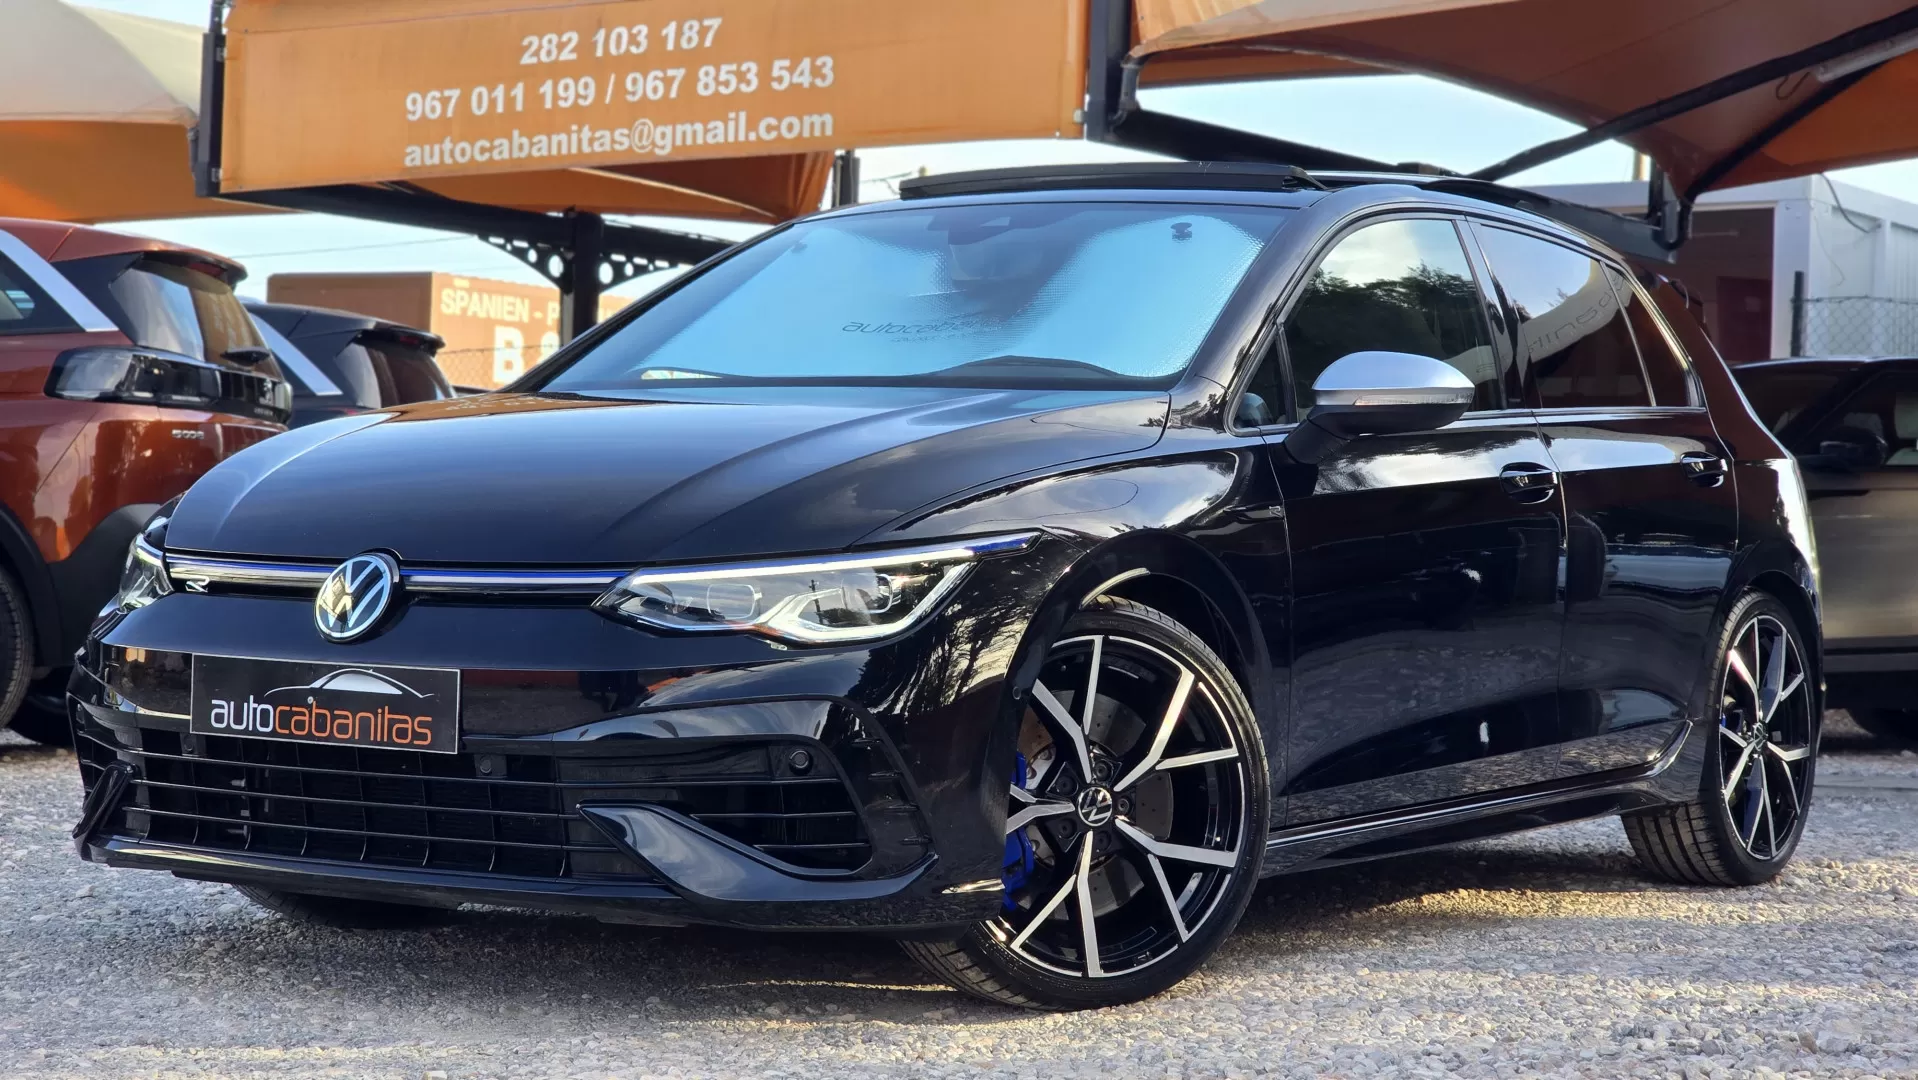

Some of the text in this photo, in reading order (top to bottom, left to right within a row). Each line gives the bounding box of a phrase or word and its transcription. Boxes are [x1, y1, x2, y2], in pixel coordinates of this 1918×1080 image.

[520, 17, 722, 65] 282 103 187
[405, 88, 461, 121] 967
[470, 82, 525, 117] 011
[538, 76, 596, 110] 199
[625, 68, 685, 103] 967
[697, 63, 759, 97] 853
[770, 56, 835, 91] 543
[404, 111, 833, 167] autocabanitas@gmail.com
[440, 288, 530, 323] SPANIEN
[210, 695, 433, 746] autocabanitas
